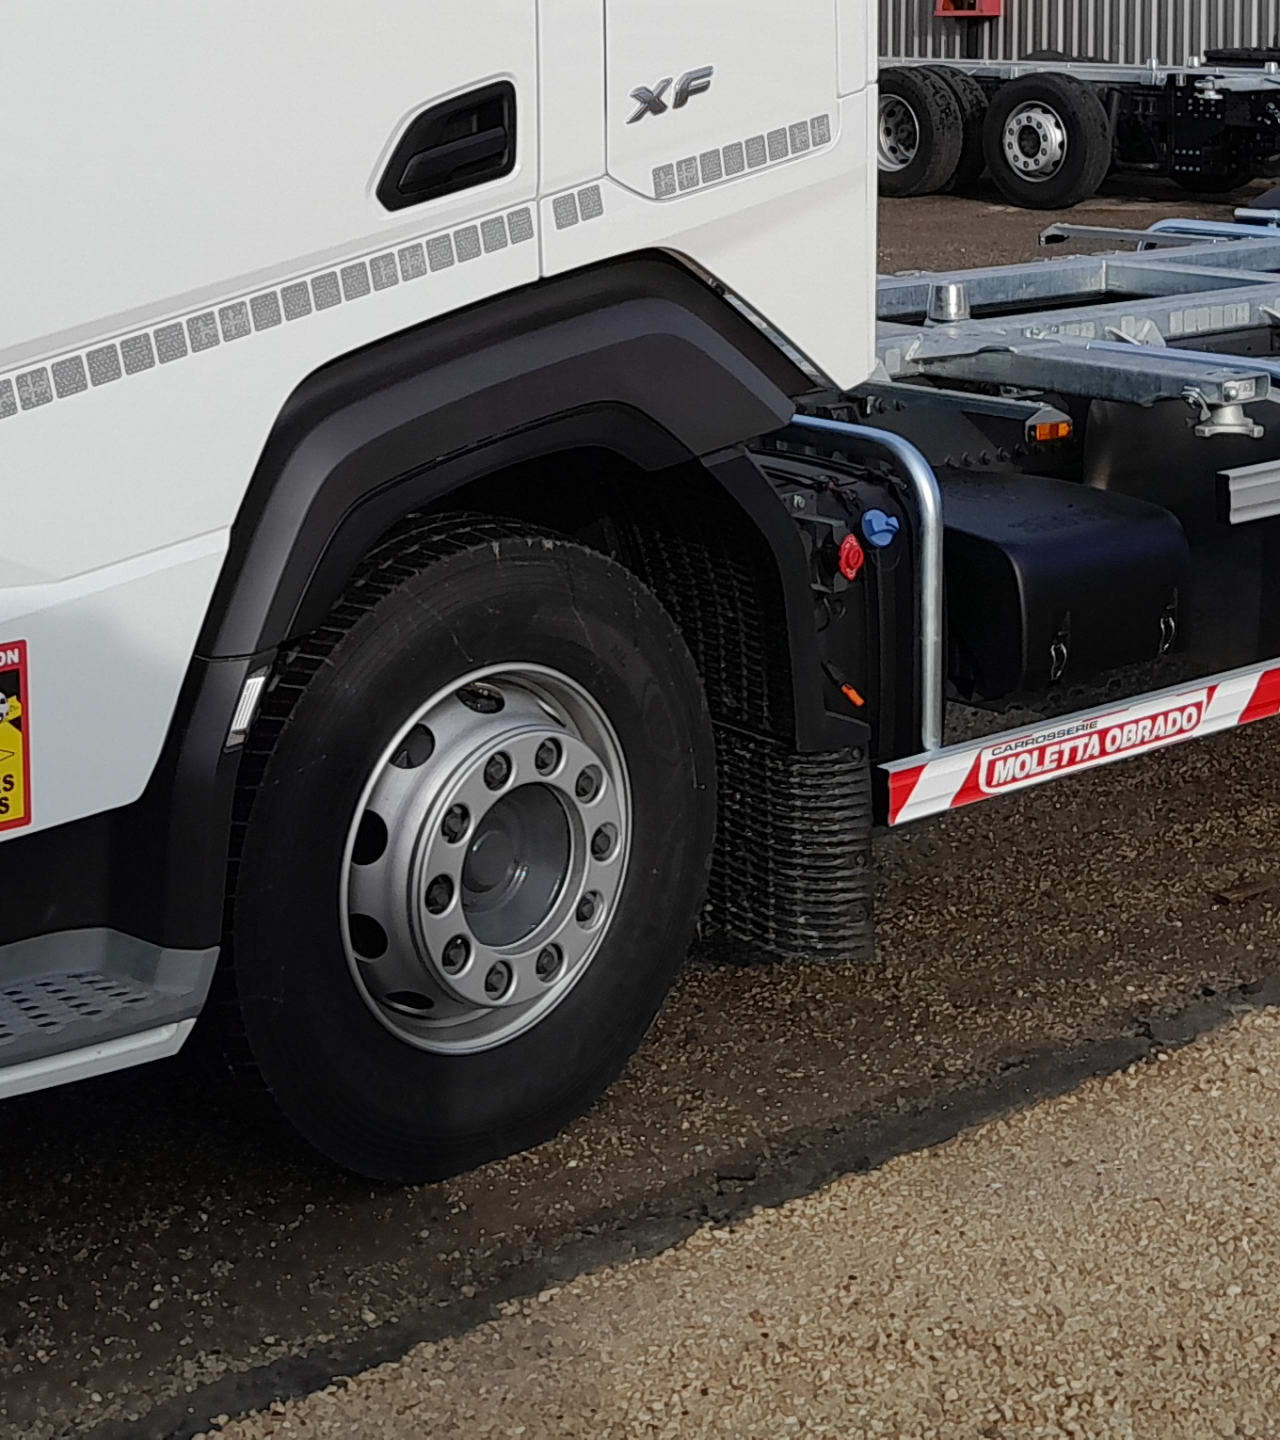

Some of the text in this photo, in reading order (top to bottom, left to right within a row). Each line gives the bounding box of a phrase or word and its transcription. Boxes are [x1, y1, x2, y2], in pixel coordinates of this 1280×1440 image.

[626, 65, 713, 125] XF
[991, 720, 1099, 757] CARROSSERIE
[991, 706, 1199, 786] MOLETTA OBRADO
